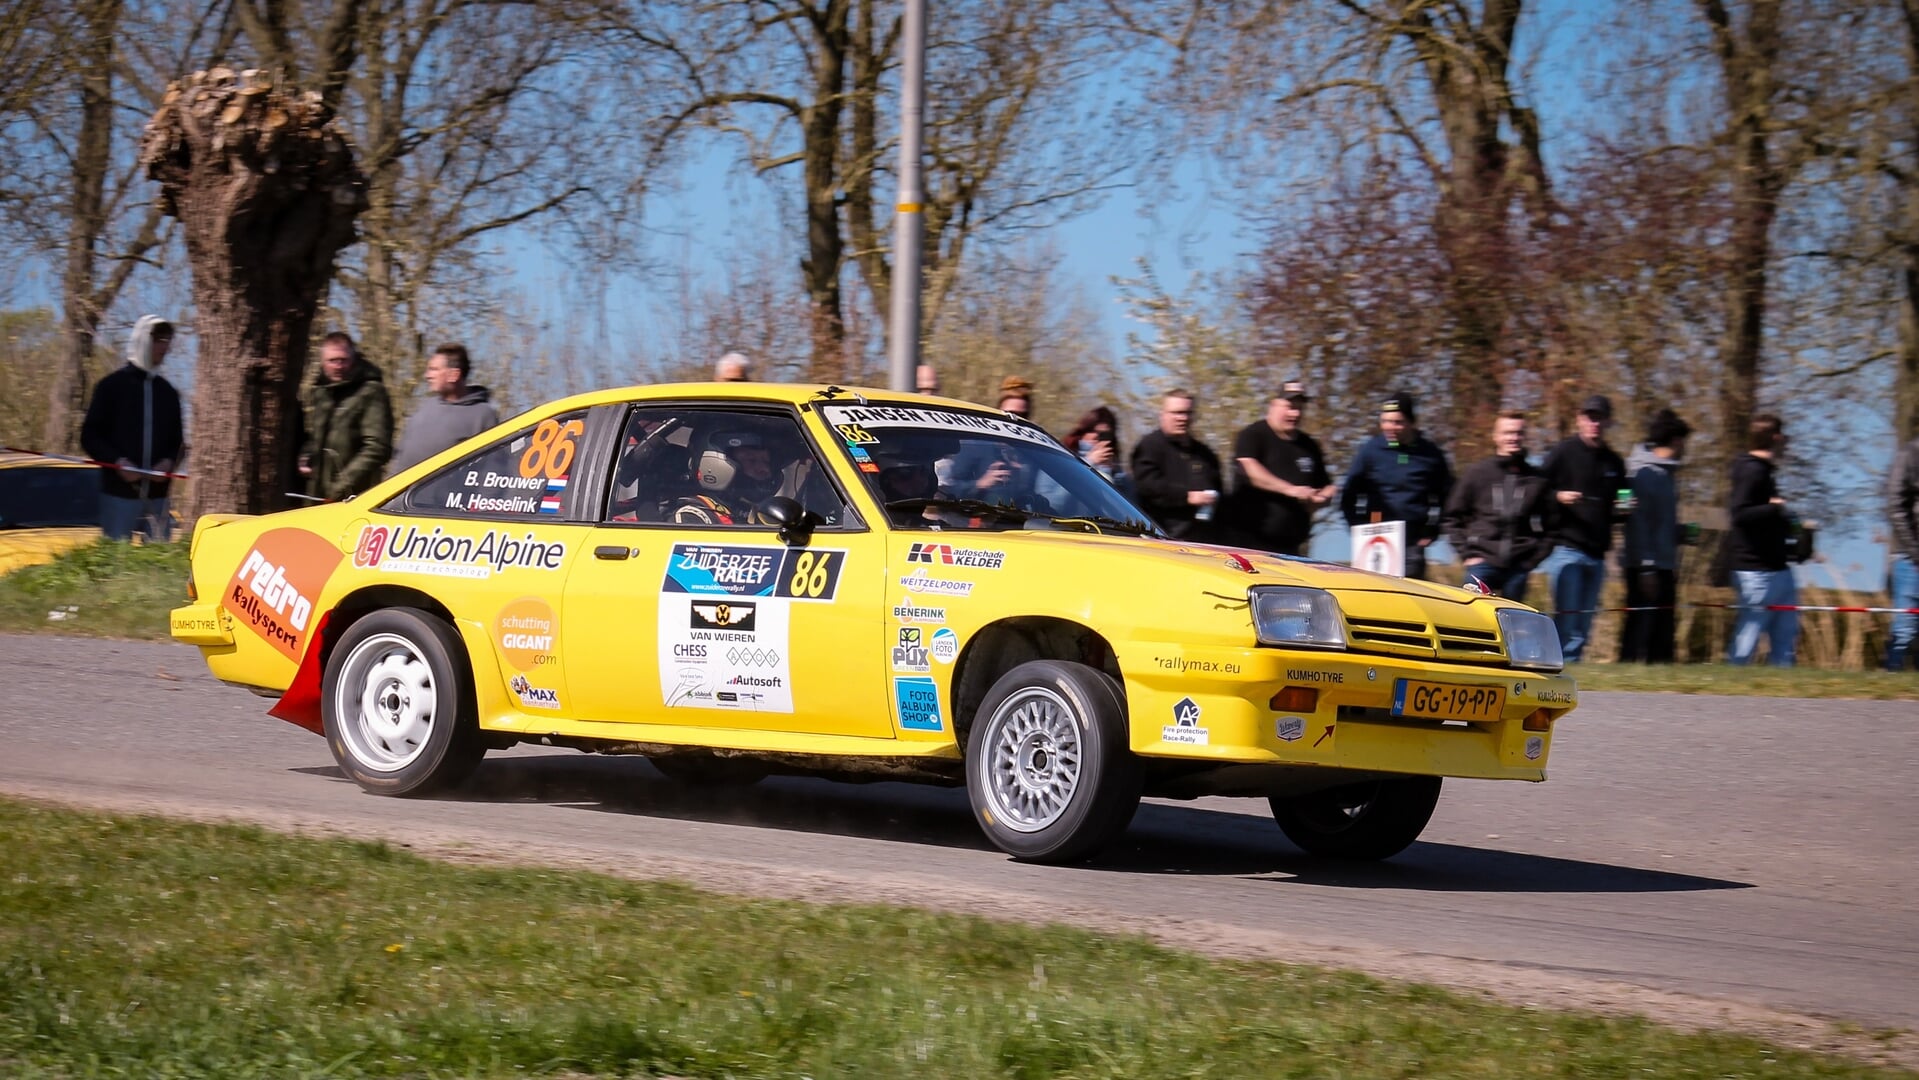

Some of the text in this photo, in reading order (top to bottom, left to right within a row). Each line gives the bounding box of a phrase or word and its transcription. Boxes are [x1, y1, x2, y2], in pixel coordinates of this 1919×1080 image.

[840, 408, 921, 423] JANSEN
[926, 411, 1000, 431] TUNING
[838, 424, 873, 442] 86
[519, 418, 584, 479] 86
[464, 471, 545, 490] B. Brouwer
[445, 492, 538, 513] M. Hesselink
[953, 548, 1005, 559] autoschade
[677, 552, 772, 570] ZUIDERZEE
[955, 556, 1002, 568] KELDER
[713, 566, 771, 584] RALLY
[790, 551, 831, 597] 86
[238, 549, 311, 632] retro
[901, 577, 973, 591] WEITZELPOORT
[232, 585, 298, 650] Rallysport
[894, 607, 944, 618] BENERINK
[197, 620, 215, 630] TYRE
[502, 616, 550, 634] schutting
[503, 633, 553, 651] GIGANT
[690, 632, 756, 643] VAN WIEREN
[673, 643, 707, 657] CHESS
[935, 645, 953, 653] FOTO
[531, 654, 557, 665] .com
[736, 675, 782, 688] Autosoft
[1286, 669, 1344, 684] KUMHO TYRE
[529, 689, 558, 702] MAX
[909, 691, 935, 702] FOTO
[1414, 686, 1497, 715] GG-19-PP
[901, 701, 937, 712] ALBUM
[902, 712, 929, 722] SHOP
[1163, 735, 1196, 743] Race-Rally
